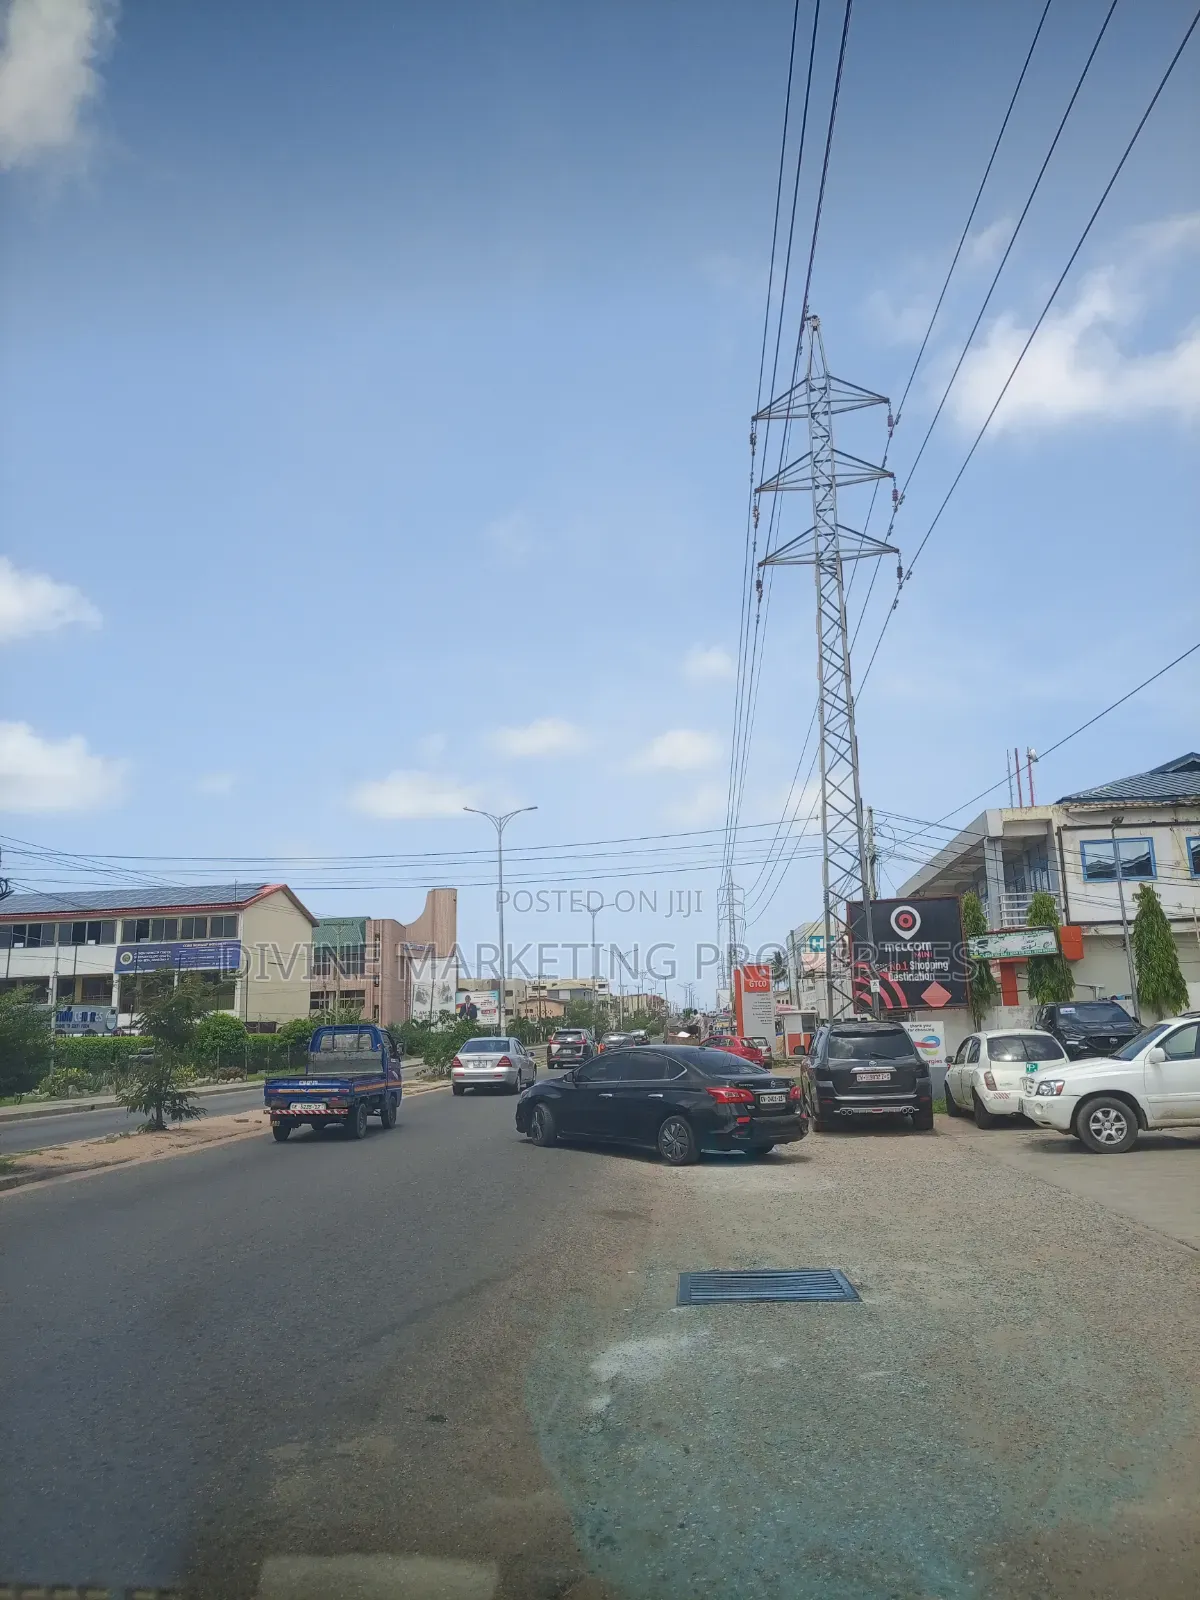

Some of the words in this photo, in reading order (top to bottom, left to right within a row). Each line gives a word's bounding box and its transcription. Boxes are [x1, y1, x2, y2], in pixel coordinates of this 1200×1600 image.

[890, 960, 908, 971] No.1
[910, 960, 949, 972] Shopping
[888, 971, 935, 982] Destination
[749, 980, 767, 988] GTCO
